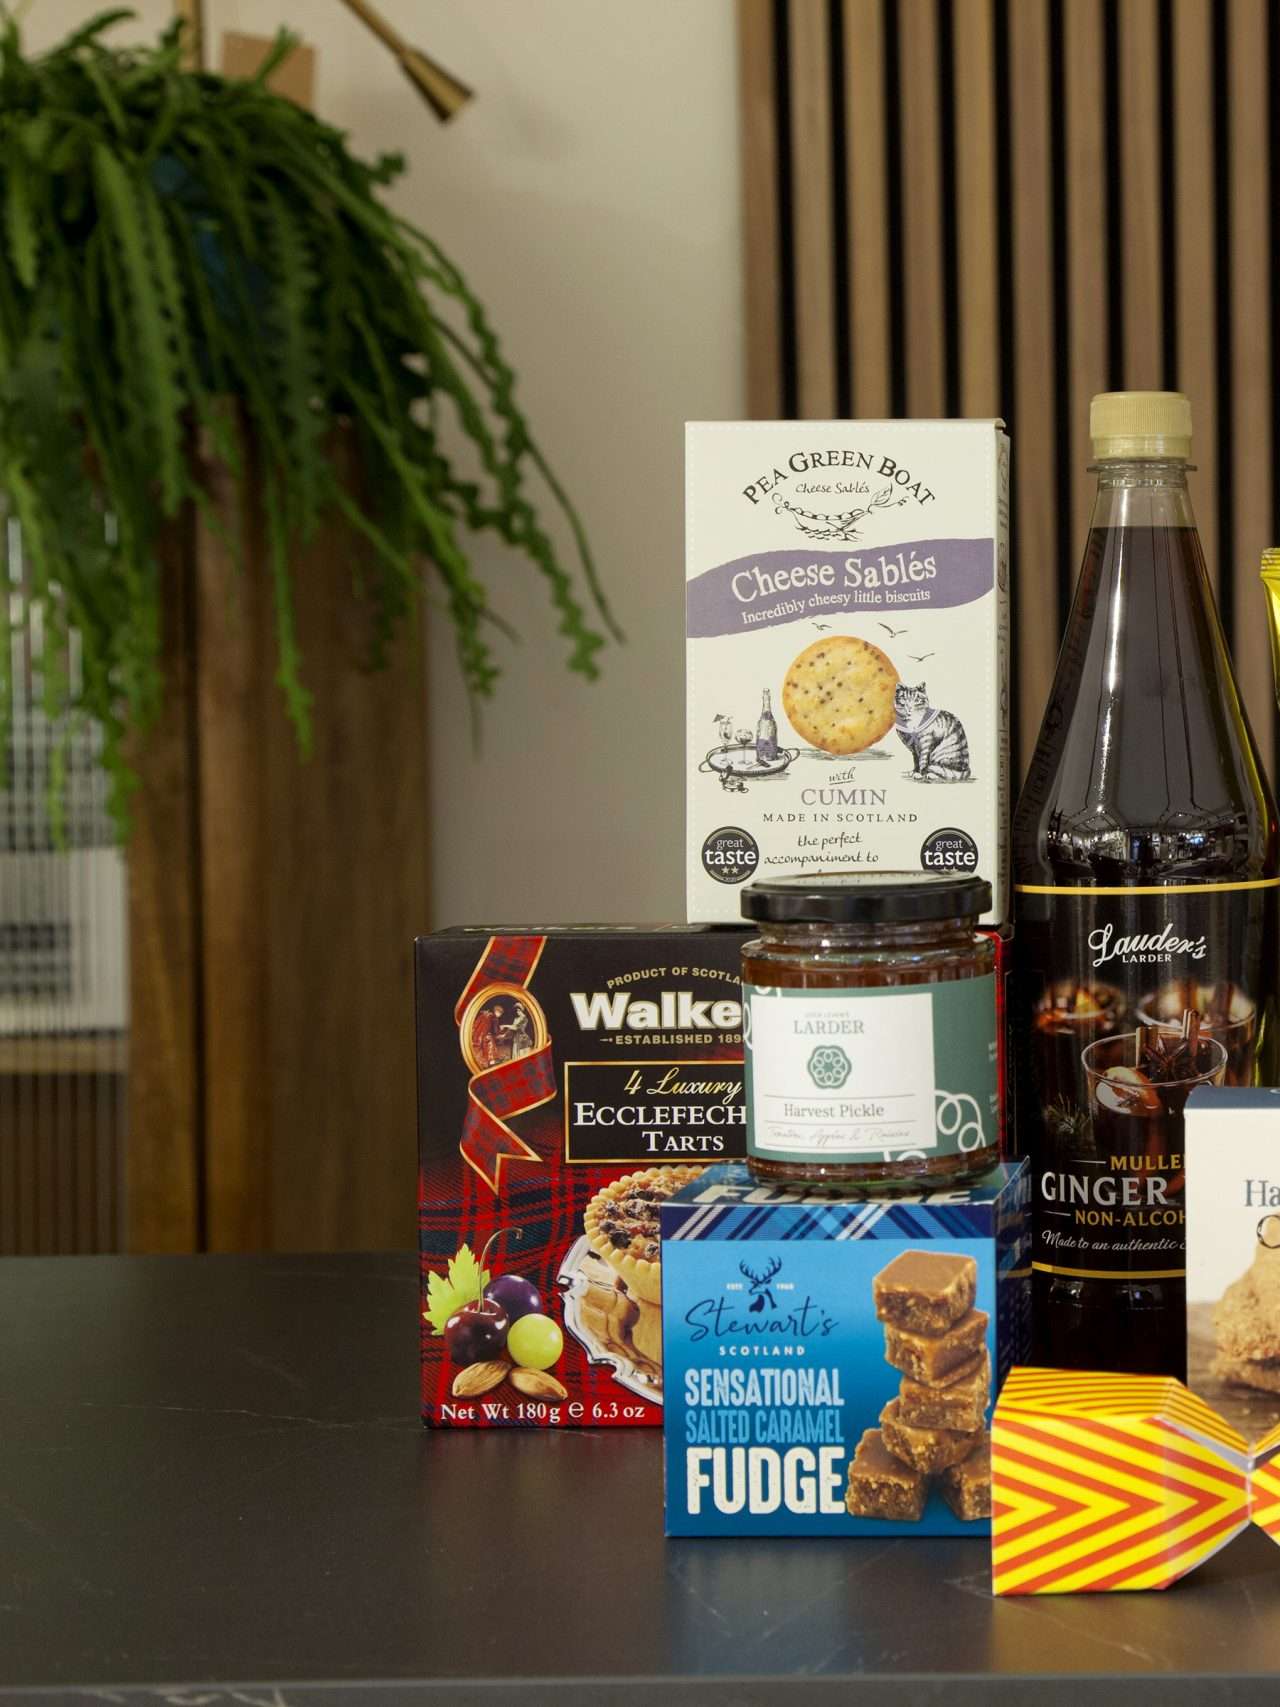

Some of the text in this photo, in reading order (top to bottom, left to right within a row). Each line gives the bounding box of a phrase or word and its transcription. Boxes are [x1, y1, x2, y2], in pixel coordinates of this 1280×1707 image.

[742, 450, 936, 506] PEA GREEN BOAT
[795, 482, 832, 494] Cheese
[731, 551, 937, 603] Cheese Sablés
[742, 589, 931, 624] Incredibly cheesy little biscuits
[828, 767, 857, 782] with
[801, 788, 887, 806] CUMIN
[763, 813, 918, 823] MADE IN SCOTLAND
[716, 838, 744, 850] great
[798, 831, 863, 850] the perfect
[935, 838, 963, 850] great
[704, 848, 757, 866] taste
[764, 852, 880, 868] accompaniment to
[924, 849, 976, 866] taste
[1087, 923, 1207, 968] Lauder's
[1122, 953, 1172, 964] LARDER
[607, 967, 743, 989] PRODUCT OF SCOTLA
[793, 1020, 865, 1034] LARDER
[615, 1034, 745, 1045] ESTABLISHED 189
[624, 1067, 742, 1105] 4 Luxury
[784, 1104, 884, 1118] Harvest Pickle
[642, 1131, 724, 1152] TARTS
[1110, 1154, 1185, 1170] MULLE
[1041, 1171, 1169, 1206] GINGER
[1041, 1229, 1076, 1248] Made
[1077, 1237, 1088, 1249] to
[1092, 1240, 1110, 1250] an
[1112, 1238, 1178, 1250] authentic
[684, 1295, 840, 1342] Stewart's
[719, 1346, 806, 1356] SCOTLAND
[684, 1368, 845, 1407] SENSATIONAL
[441, 1404, 474, 1420] Net
[481, 1404, 509, 1420] Wt
[685, 1409, 845, 1444] SALTED CARAMEL
[686, 1447, 846, 1515] FUDGE
